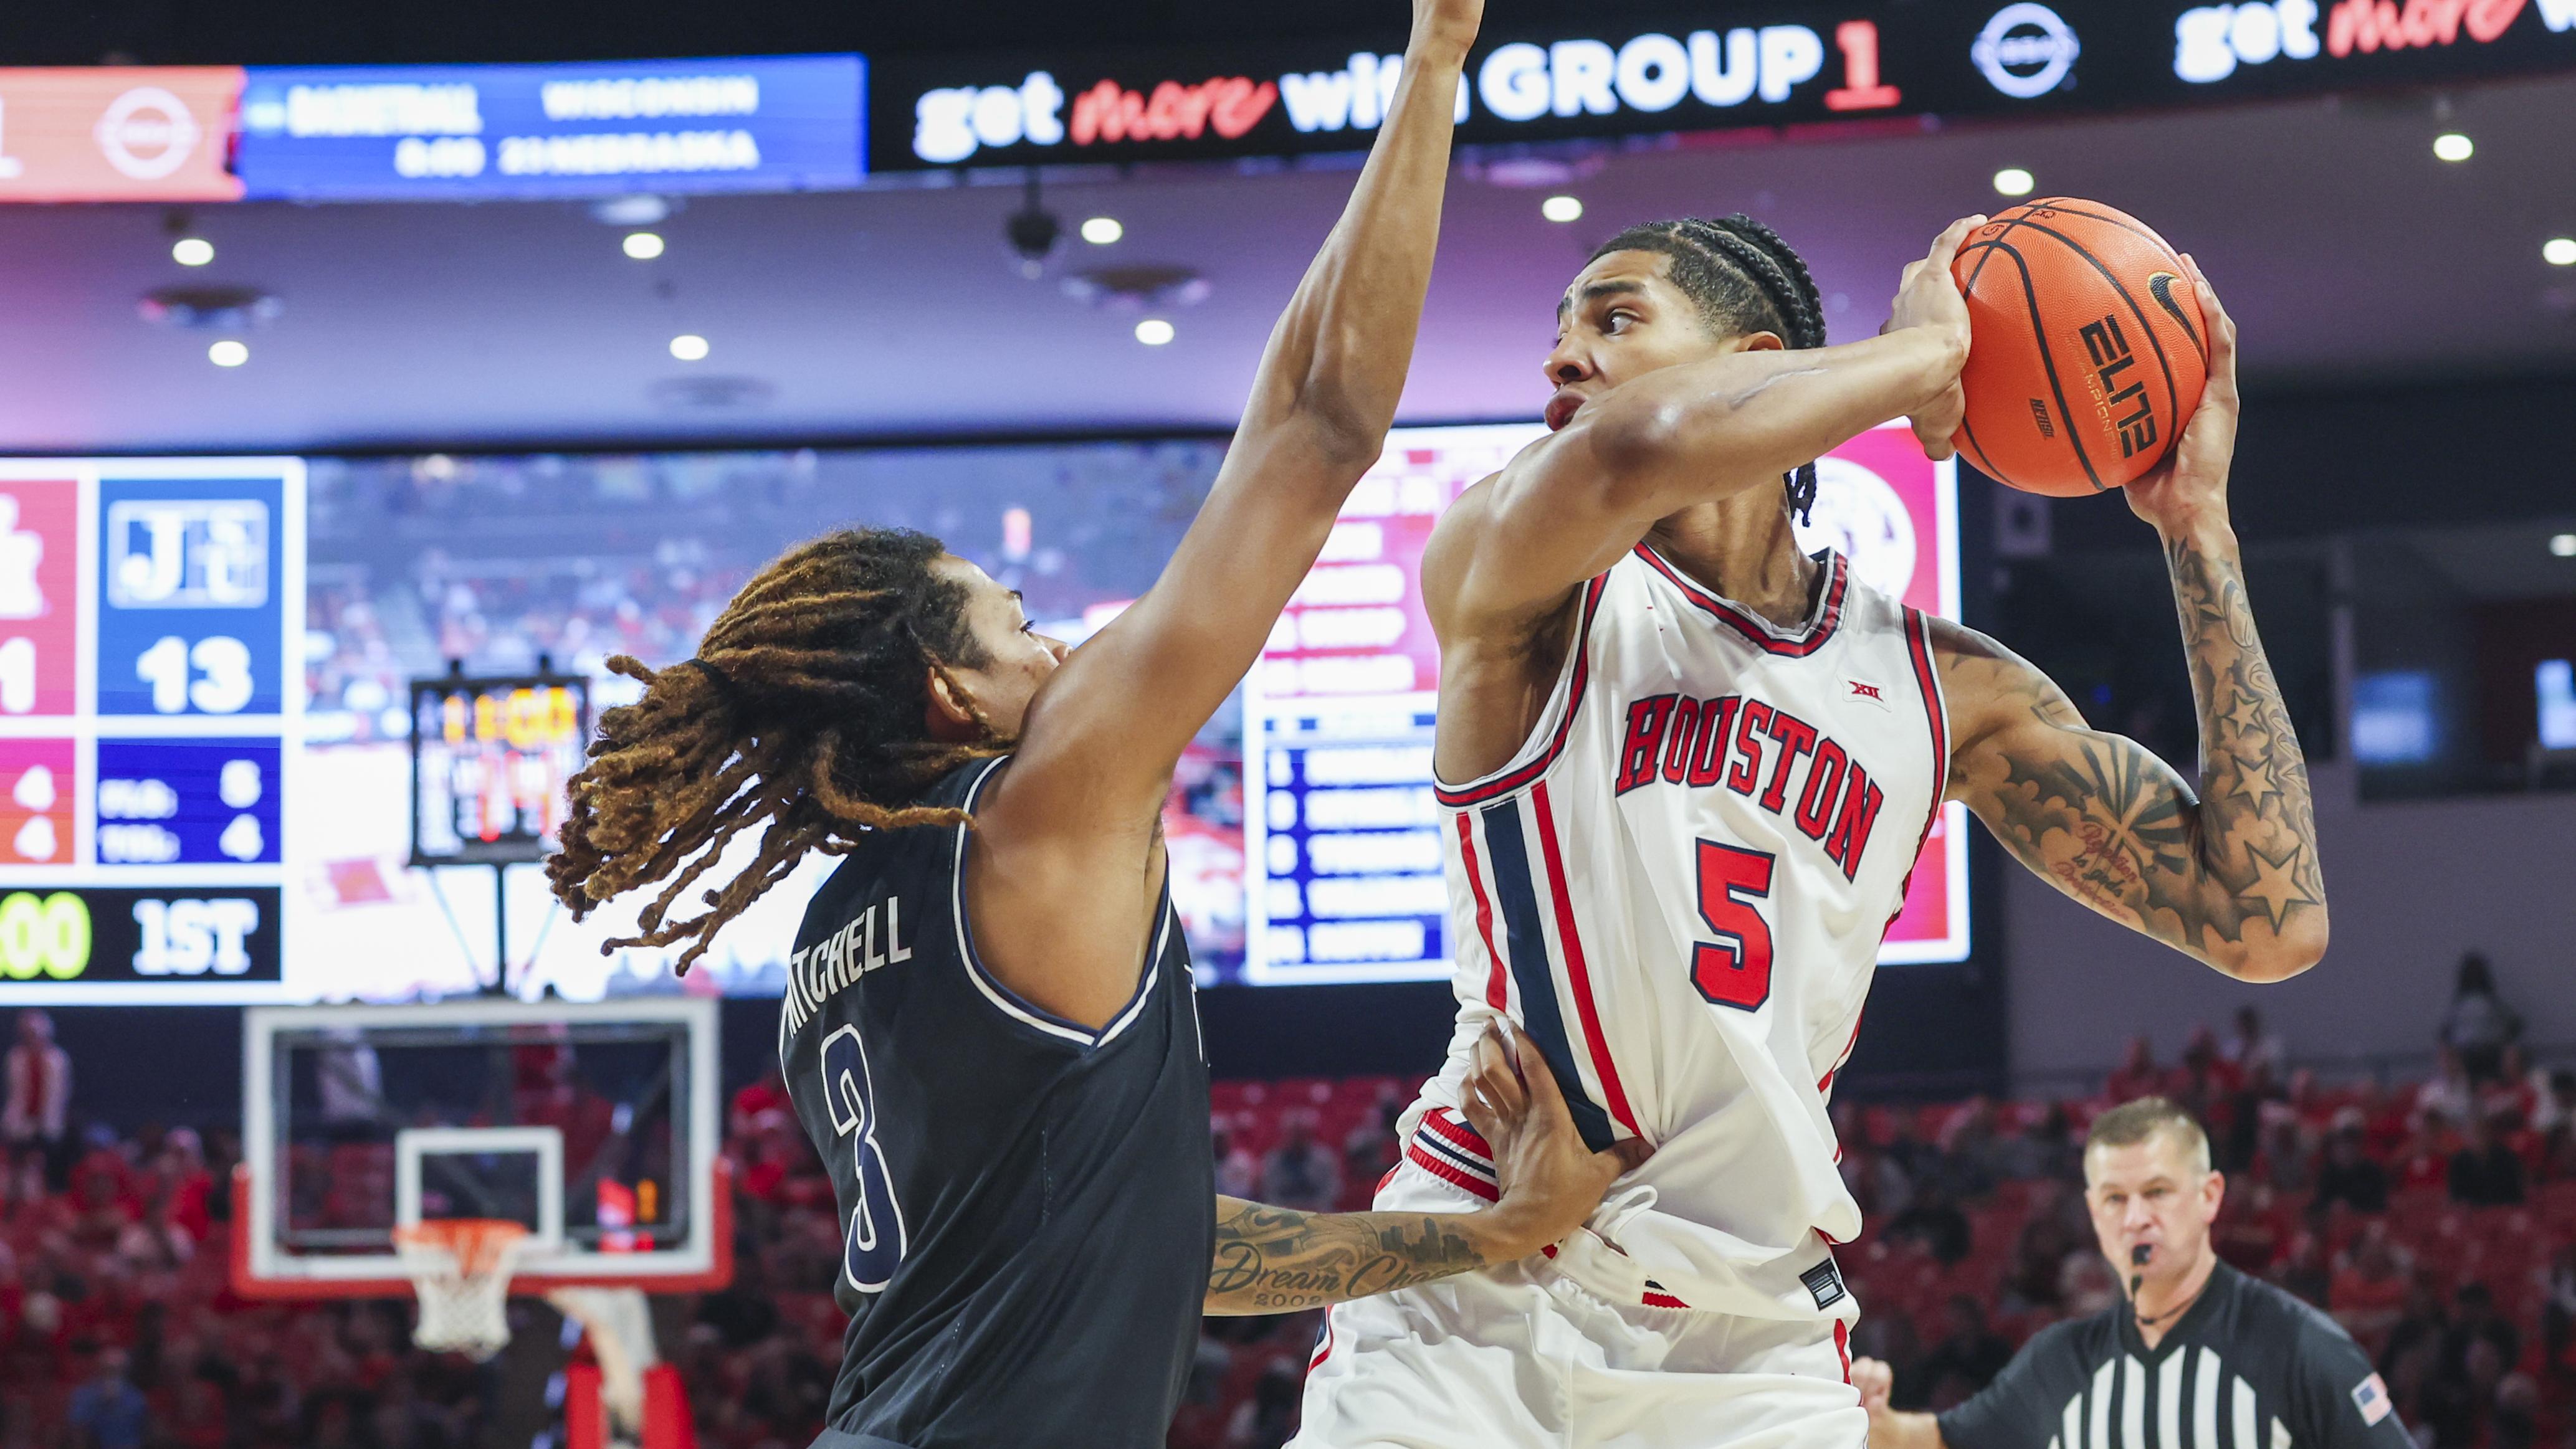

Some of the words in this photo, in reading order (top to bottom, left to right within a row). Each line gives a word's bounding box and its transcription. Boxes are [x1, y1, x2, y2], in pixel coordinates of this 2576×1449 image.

[2173, 0, 2321, 83] got
[541, 75, 760, 120] WISCONSIN
[914, 71, 1065, 163] got
[1071, 76, 1278, 145] more
[1479, 26, 1824, 121] GROUP
[1824, 19, 1901, 112] 1
[136, 635, 254, 715] 13
[1615, 693, 1884, 884] HOUSTON
[132, 898, 259, 976] 1ST
[1690, 837, 1776, 1012] 5
[820, 1023, 908, 1294] 3
[1208, 1241, 1341, 1295] Dream
